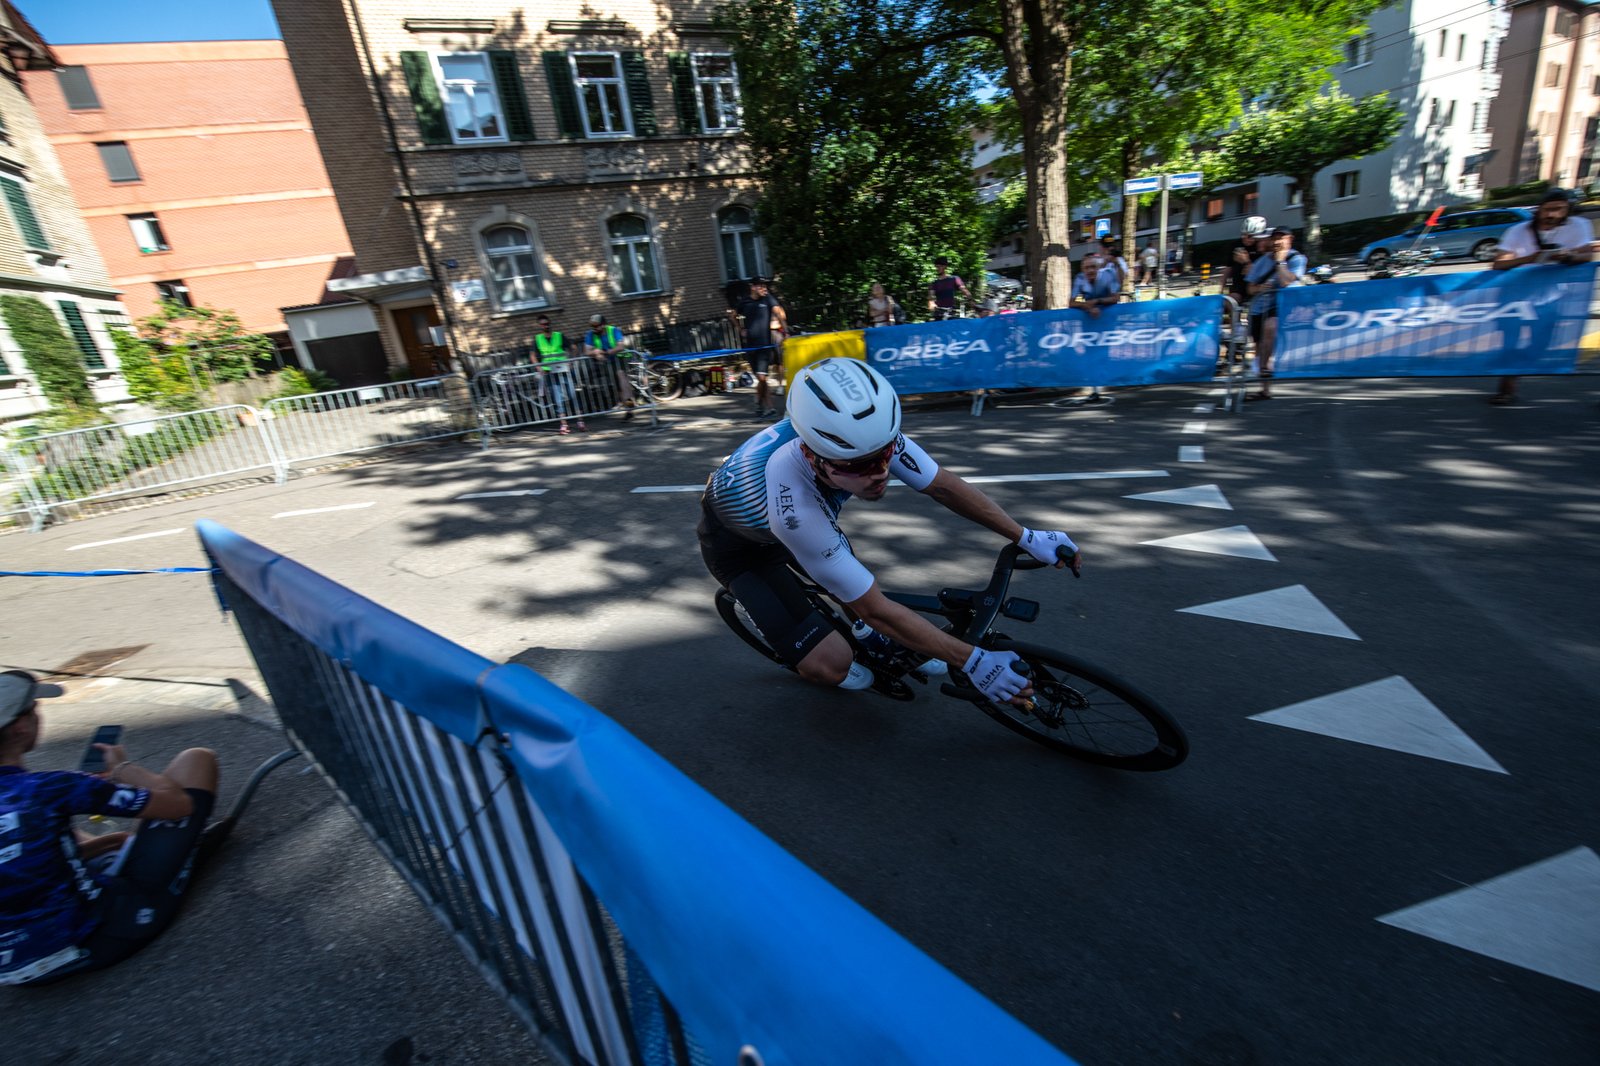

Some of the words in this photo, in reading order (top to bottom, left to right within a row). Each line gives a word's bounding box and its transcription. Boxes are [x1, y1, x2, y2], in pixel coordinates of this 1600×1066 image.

[1313, 300, 1539, 331] ORBEA
[874, 339, 991, 362] ORBEA
[1038, 327, 1187, 349] ORBEA
[822, 363, 865, 402] GIRO
[779, 484, 795, 516] AEK
